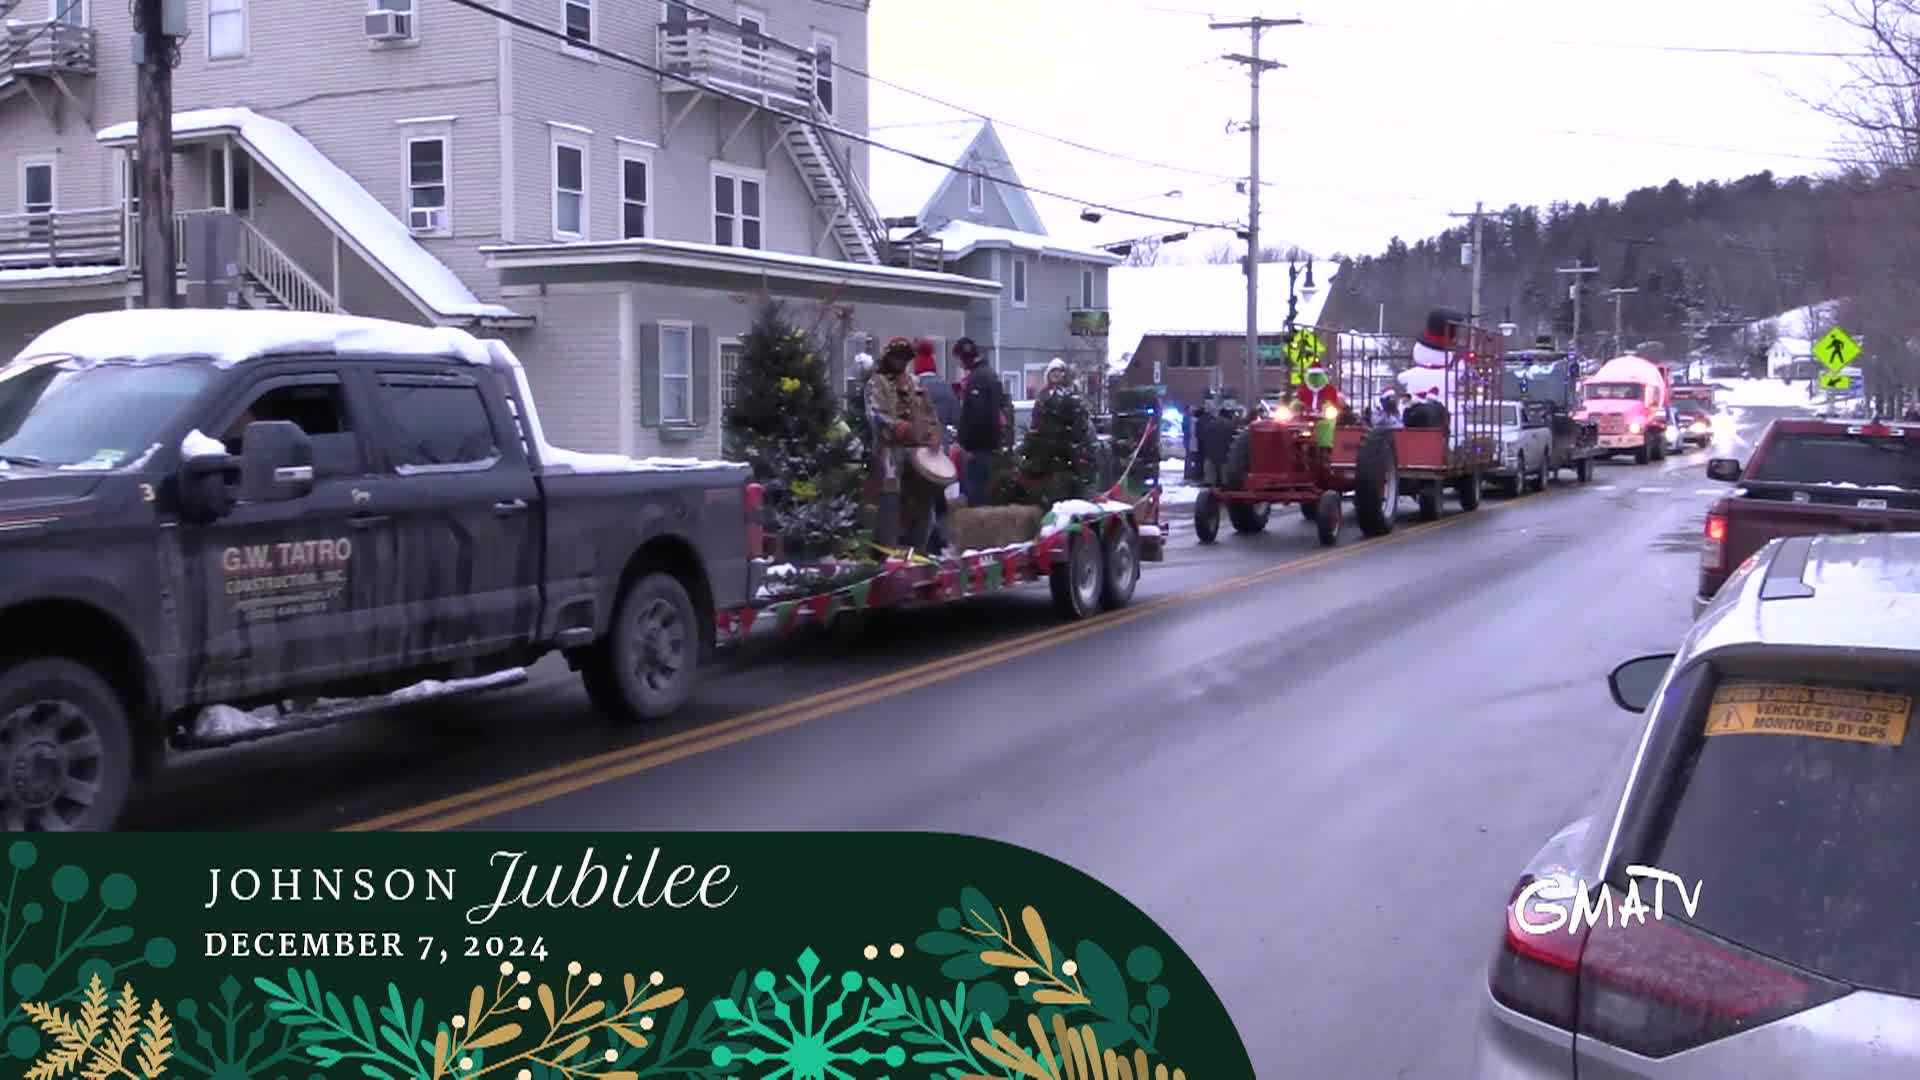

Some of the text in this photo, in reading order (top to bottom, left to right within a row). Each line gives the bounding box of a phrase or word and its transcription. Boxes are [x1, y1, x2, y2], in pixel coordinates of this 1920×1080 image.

[223, 537, 352, 571] G.W. TATRO
[1752, 717, 1888, 738] MONITORED BY GPS
[1876, 713, 1891, 725] IS
